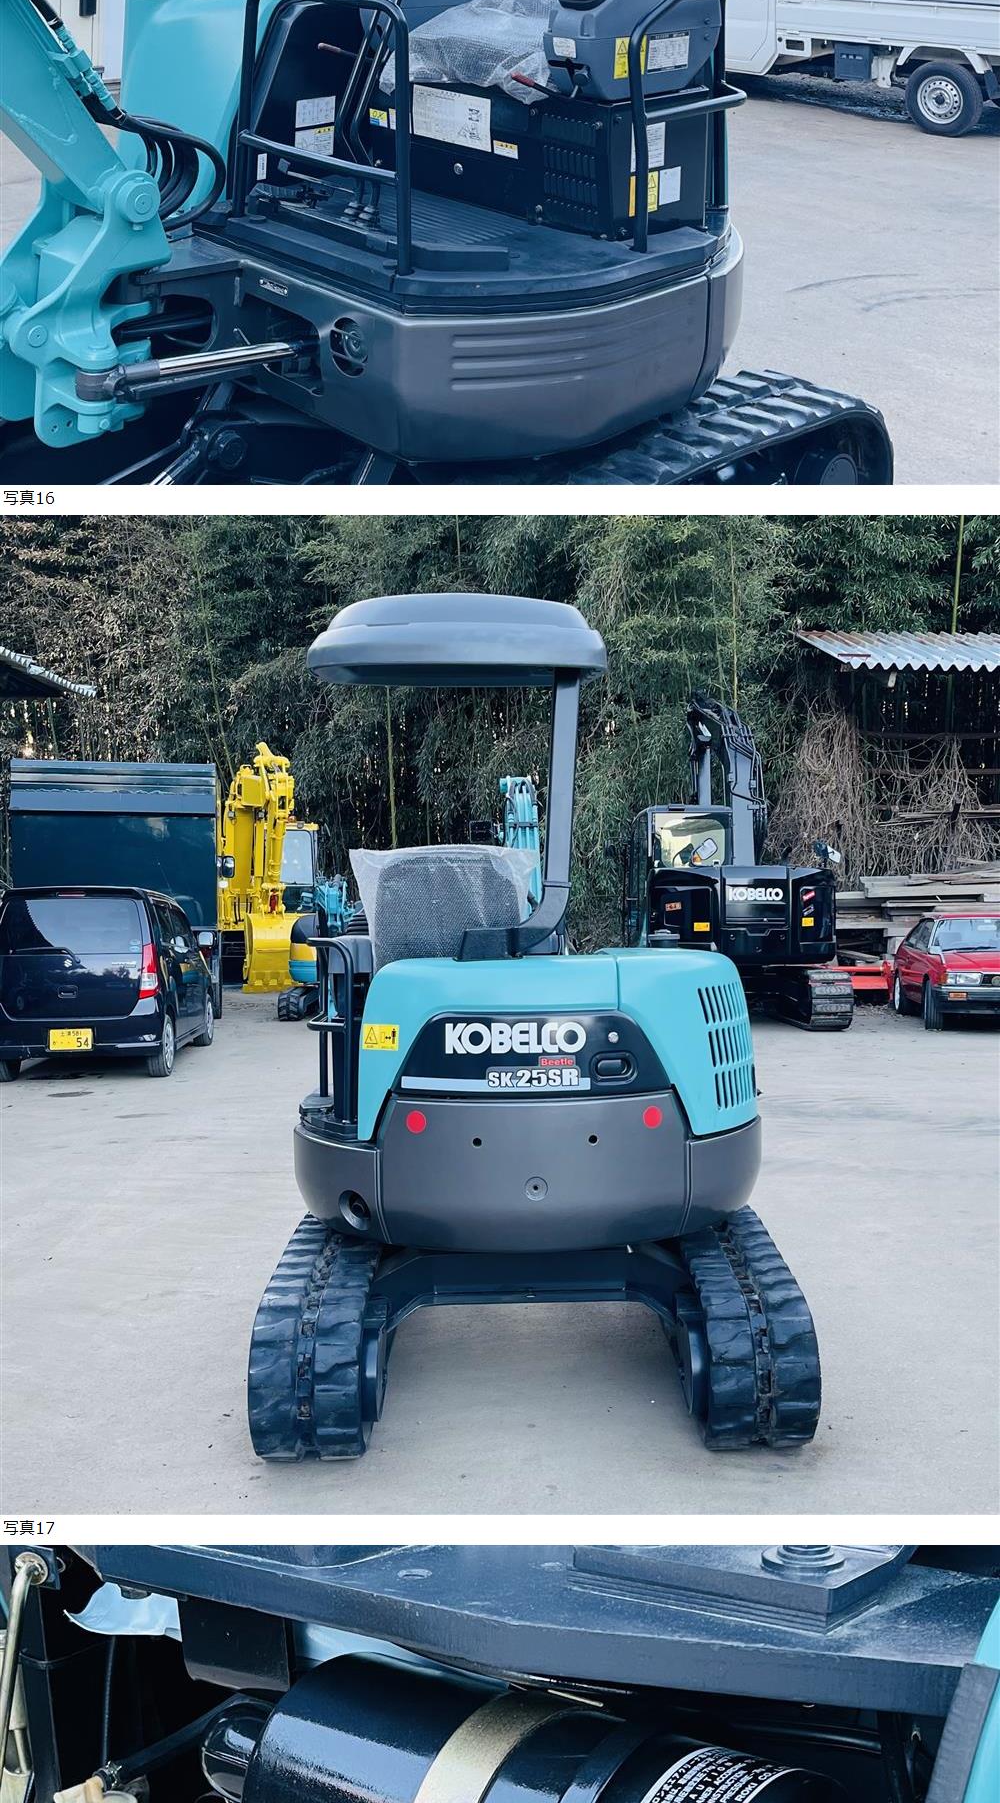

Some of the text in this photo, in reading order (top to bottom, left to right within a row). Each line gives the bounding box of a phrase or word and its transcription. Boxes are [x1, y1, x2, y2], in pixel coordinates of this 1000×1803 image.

[729, 886, 783, 901] KOBELCO
[76, 1037, 90, 1048] 54
[445, 1022, 586, 1054] KOBELCO
[541, 1057, 574, 1066] Beetle
[734, 1781, 759, 1802] ROKI
